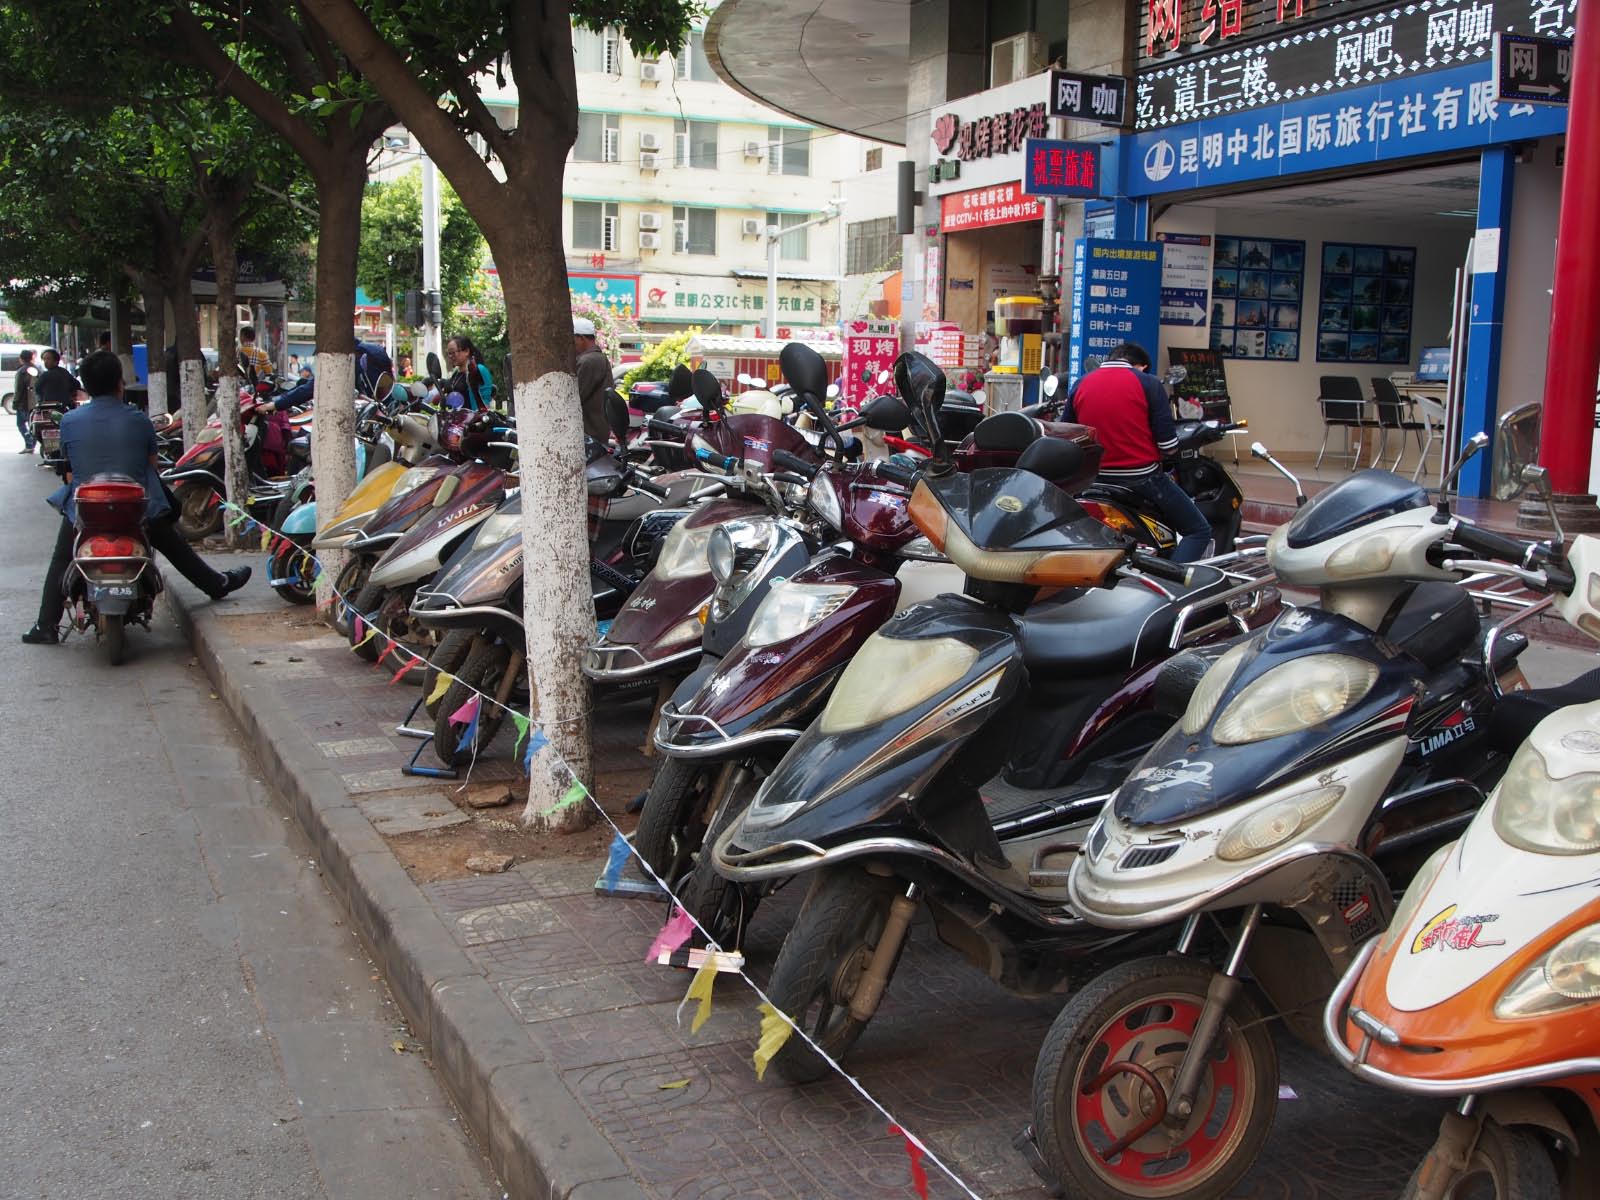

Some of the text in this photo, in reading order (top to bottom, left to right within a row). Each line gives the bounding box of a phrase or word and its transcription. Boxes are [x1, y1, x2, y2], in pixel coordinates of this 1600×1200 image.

[1147, 0, 1303, 56] 网络
[1057, 78, 1118, 115] 网咖
[1032, 147, 1096, 190] 机票旅游
[674, 292, 815, 311] 昆明公交IC卡售充值点
[853, 339, 894, 356] 现烤
